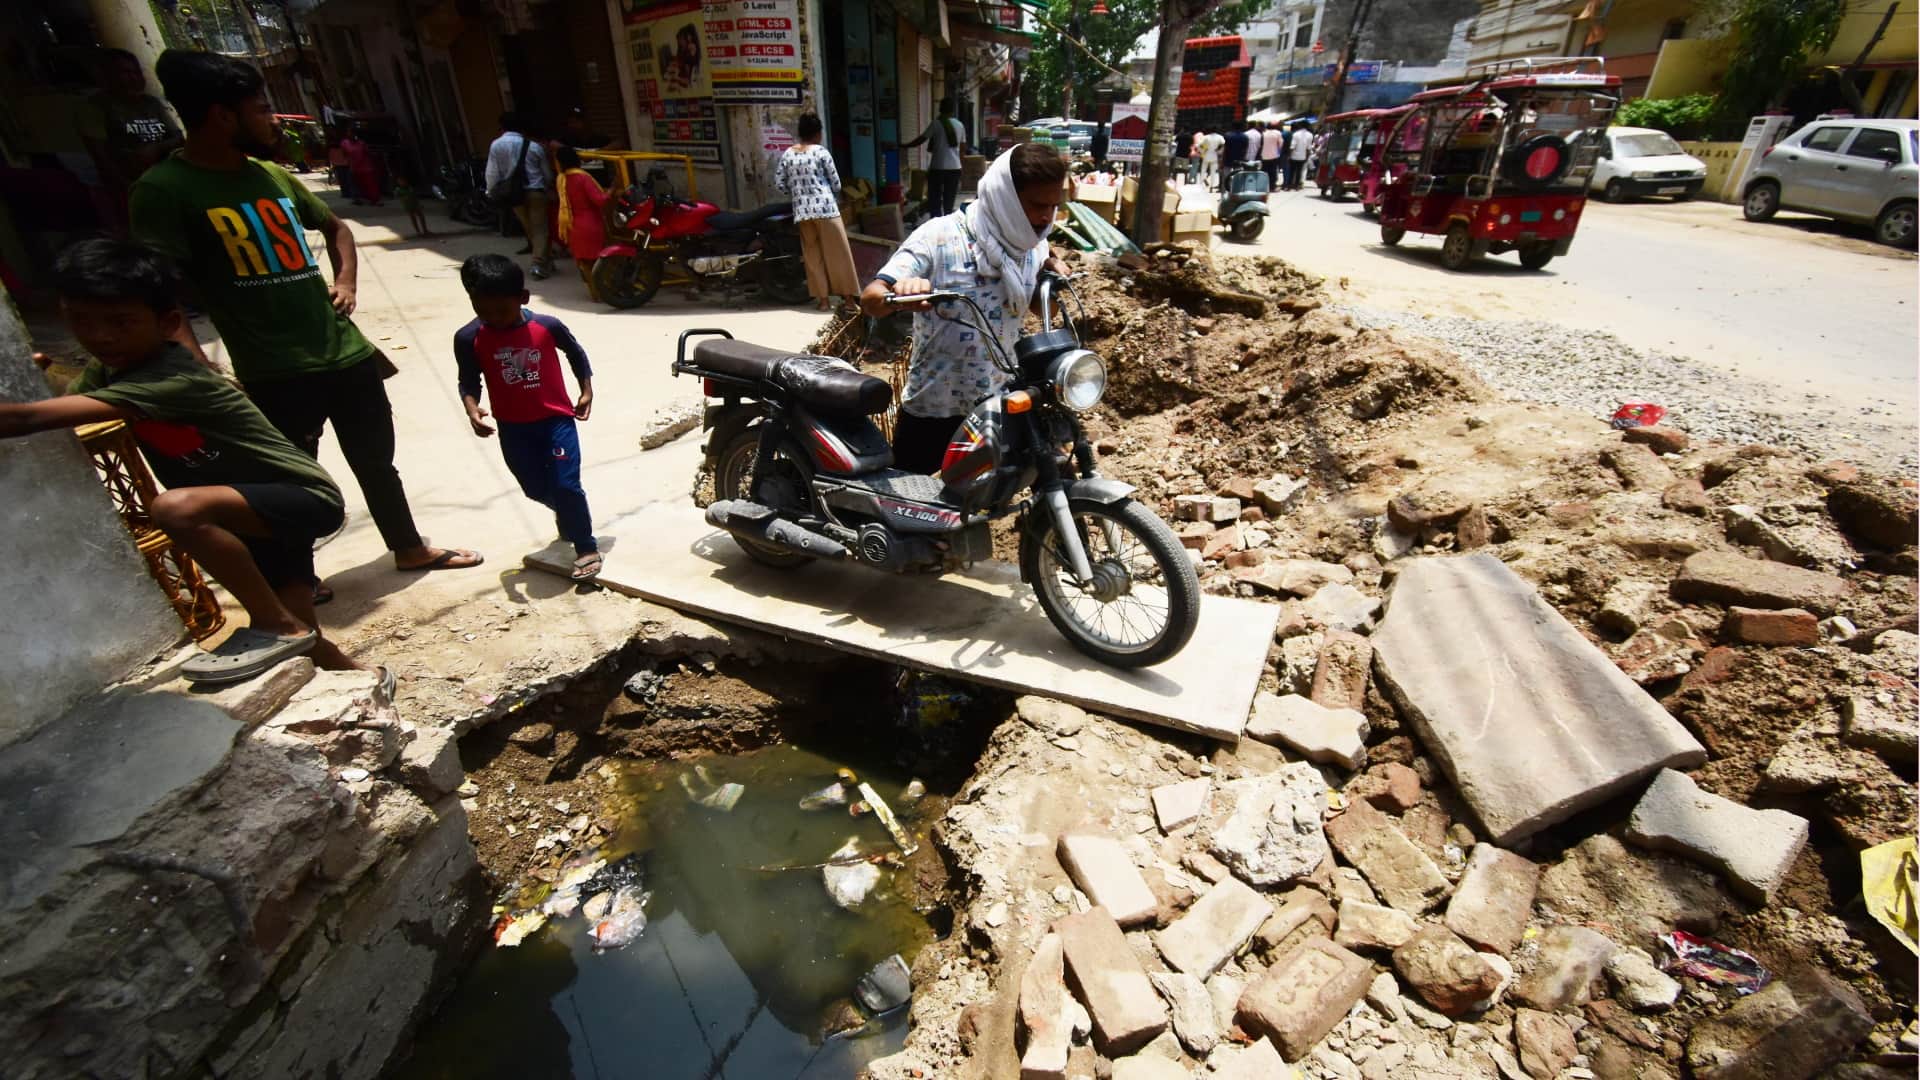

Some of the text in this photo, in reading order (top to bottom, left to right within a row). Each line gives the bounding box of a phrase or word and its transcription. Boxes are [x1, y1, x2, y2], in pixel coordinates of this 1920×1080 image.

[767, 19, 786, 27] CSS
[741, 31, 786, 40] JavaScript
[763, 46, 785, 54] ICSE
[206, 197, 319, 276] RISE
[526, 371, 540, 381] 22
[894, 506, 938, 522] XL 100
